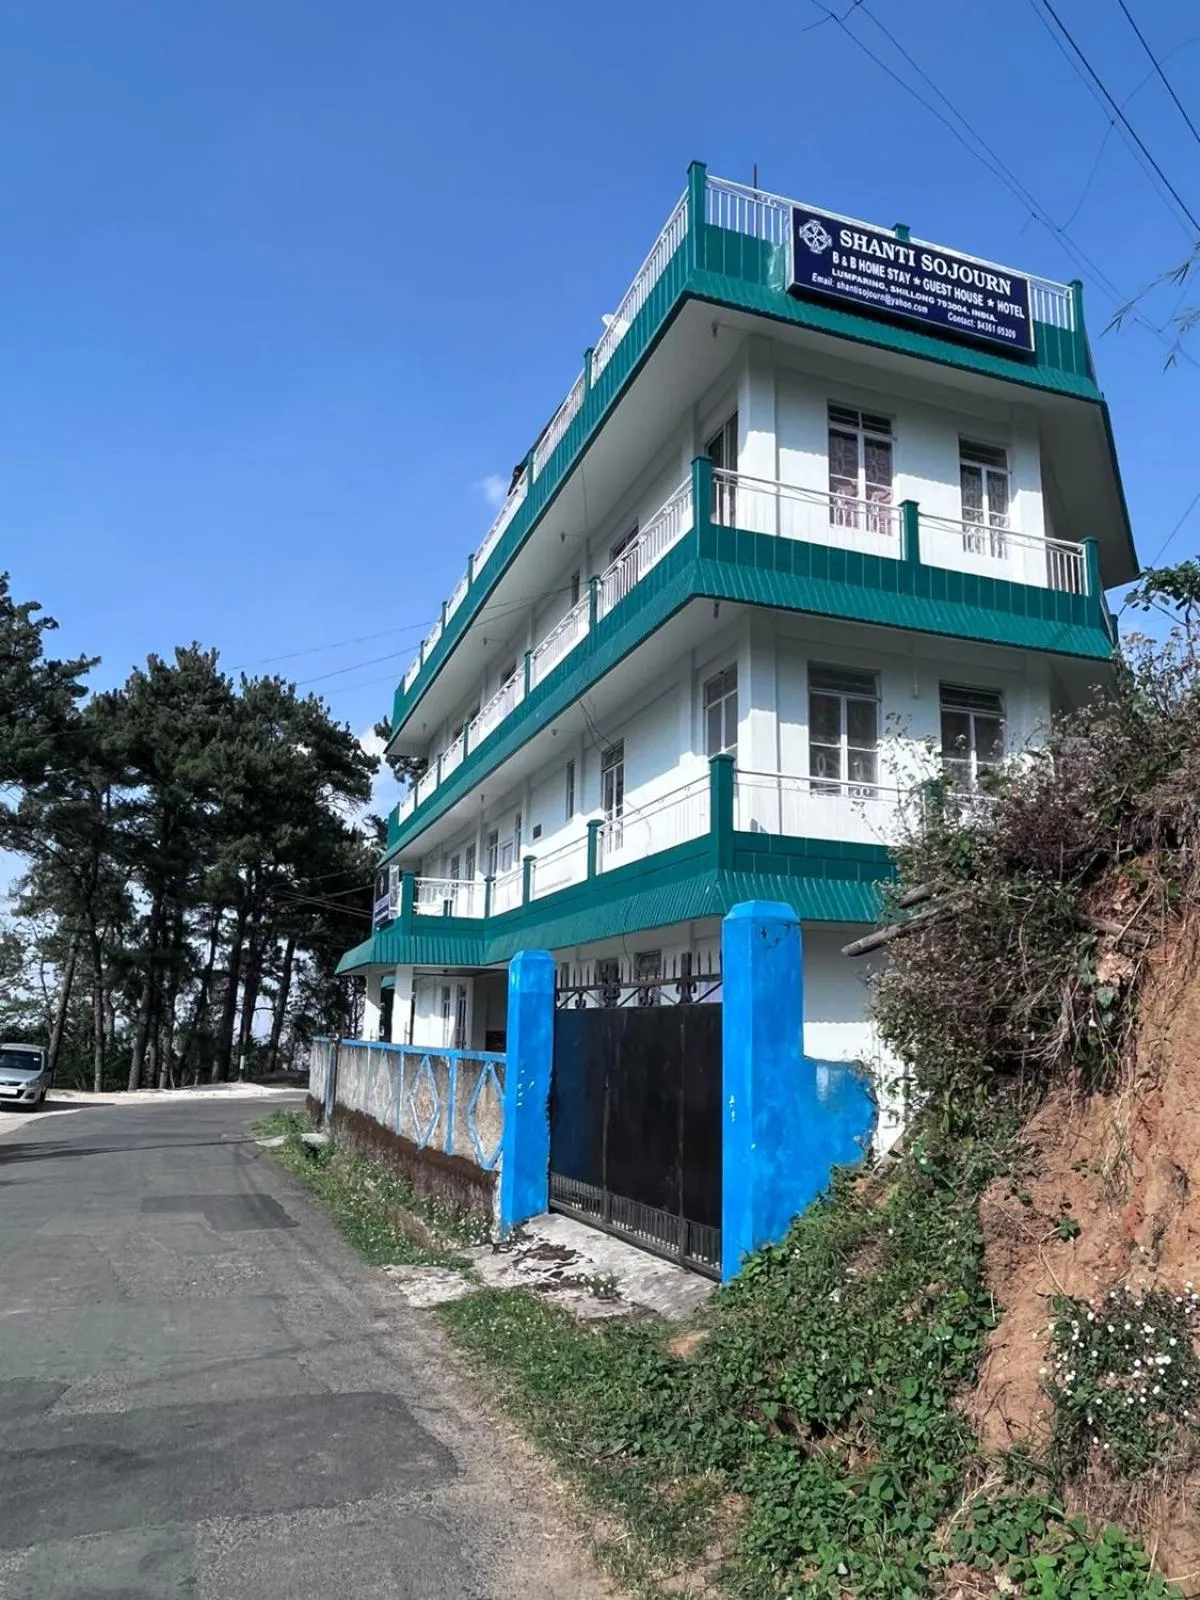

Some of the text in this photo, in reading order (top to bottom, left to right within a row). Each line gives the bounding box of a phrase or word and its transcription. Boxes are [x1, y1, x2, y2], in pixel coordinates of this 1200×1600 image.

[840, 230, 1011, 296] SHANTI SOJOURN
[812, 273, 928, 314] Email: shantisojourn@yahoo.com
[832, 251, 1025, 319] B & B HOME STAY GUEST HOUSE HOTEL
[832, 268, 888, 291] LUMPARING,
[890, 285, 935, 304] SHILLONG
[947, 312, 975, 327] Contact:
